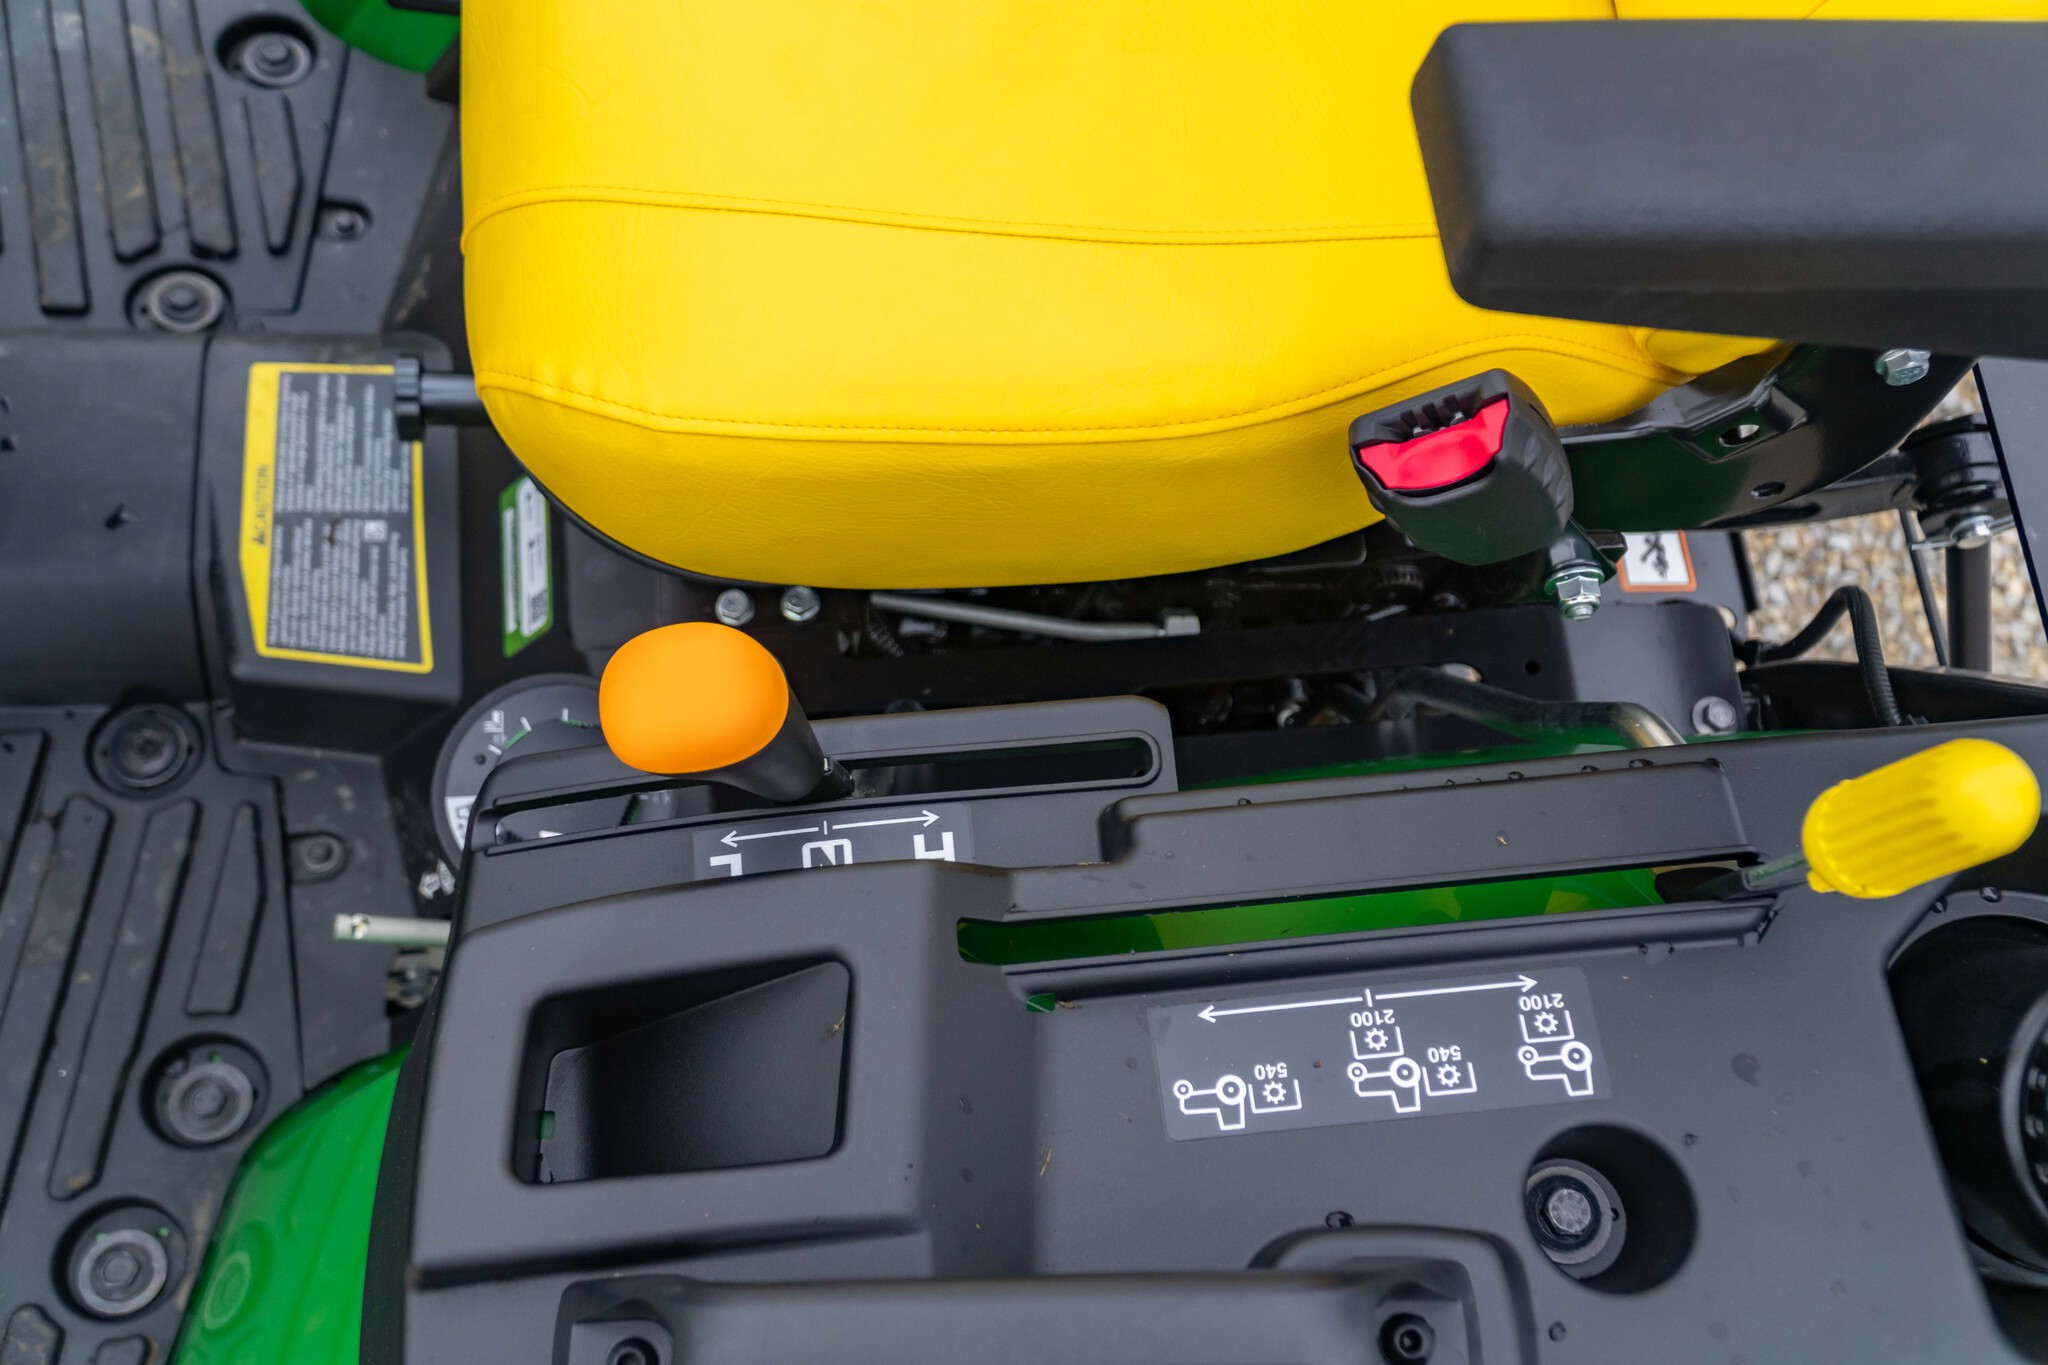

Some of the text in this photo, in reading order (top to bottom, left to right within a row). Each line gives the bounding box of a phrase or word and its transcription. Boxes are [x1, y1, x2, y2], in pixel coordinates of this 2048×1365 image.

[913, 832, 955, 862] H
[1518, 992, 1564, 1012] 2100
[1350, 1008, 1396, 1028] 2100
[1427, 1044, 1462, 1063] 540
[1253, 1061, 1288, 1081] 540
